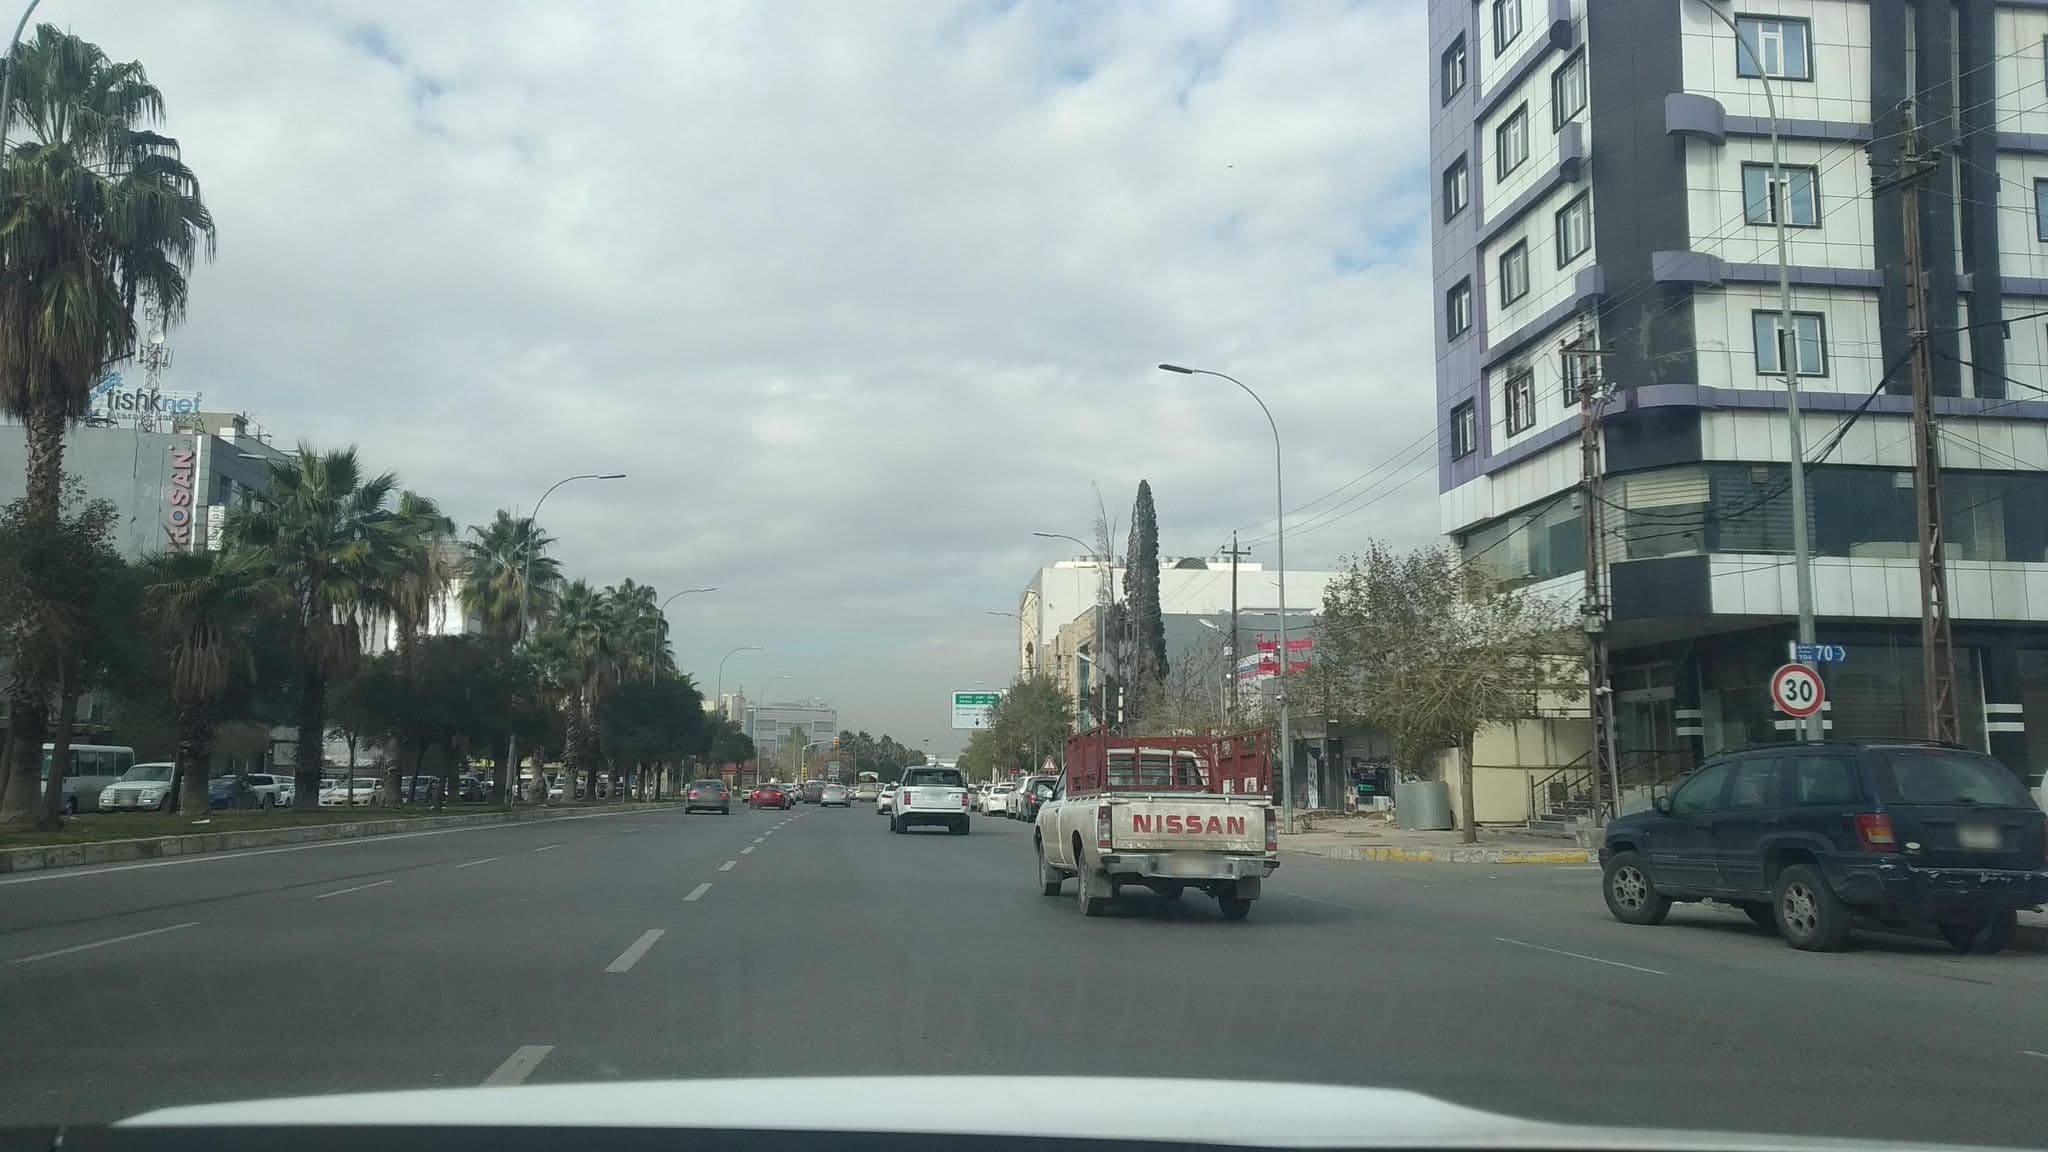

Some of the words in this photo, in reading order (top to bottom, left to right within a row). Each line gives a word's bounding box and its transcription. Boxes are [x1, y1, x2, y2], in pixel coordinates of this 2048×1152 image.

[168, 449, 195, 546] KOSAN
[1815, 645, 1833, 661] 70
[1786, 679, 1812, 702] 30
[1133, 814, 1246, 835] NISSAN
